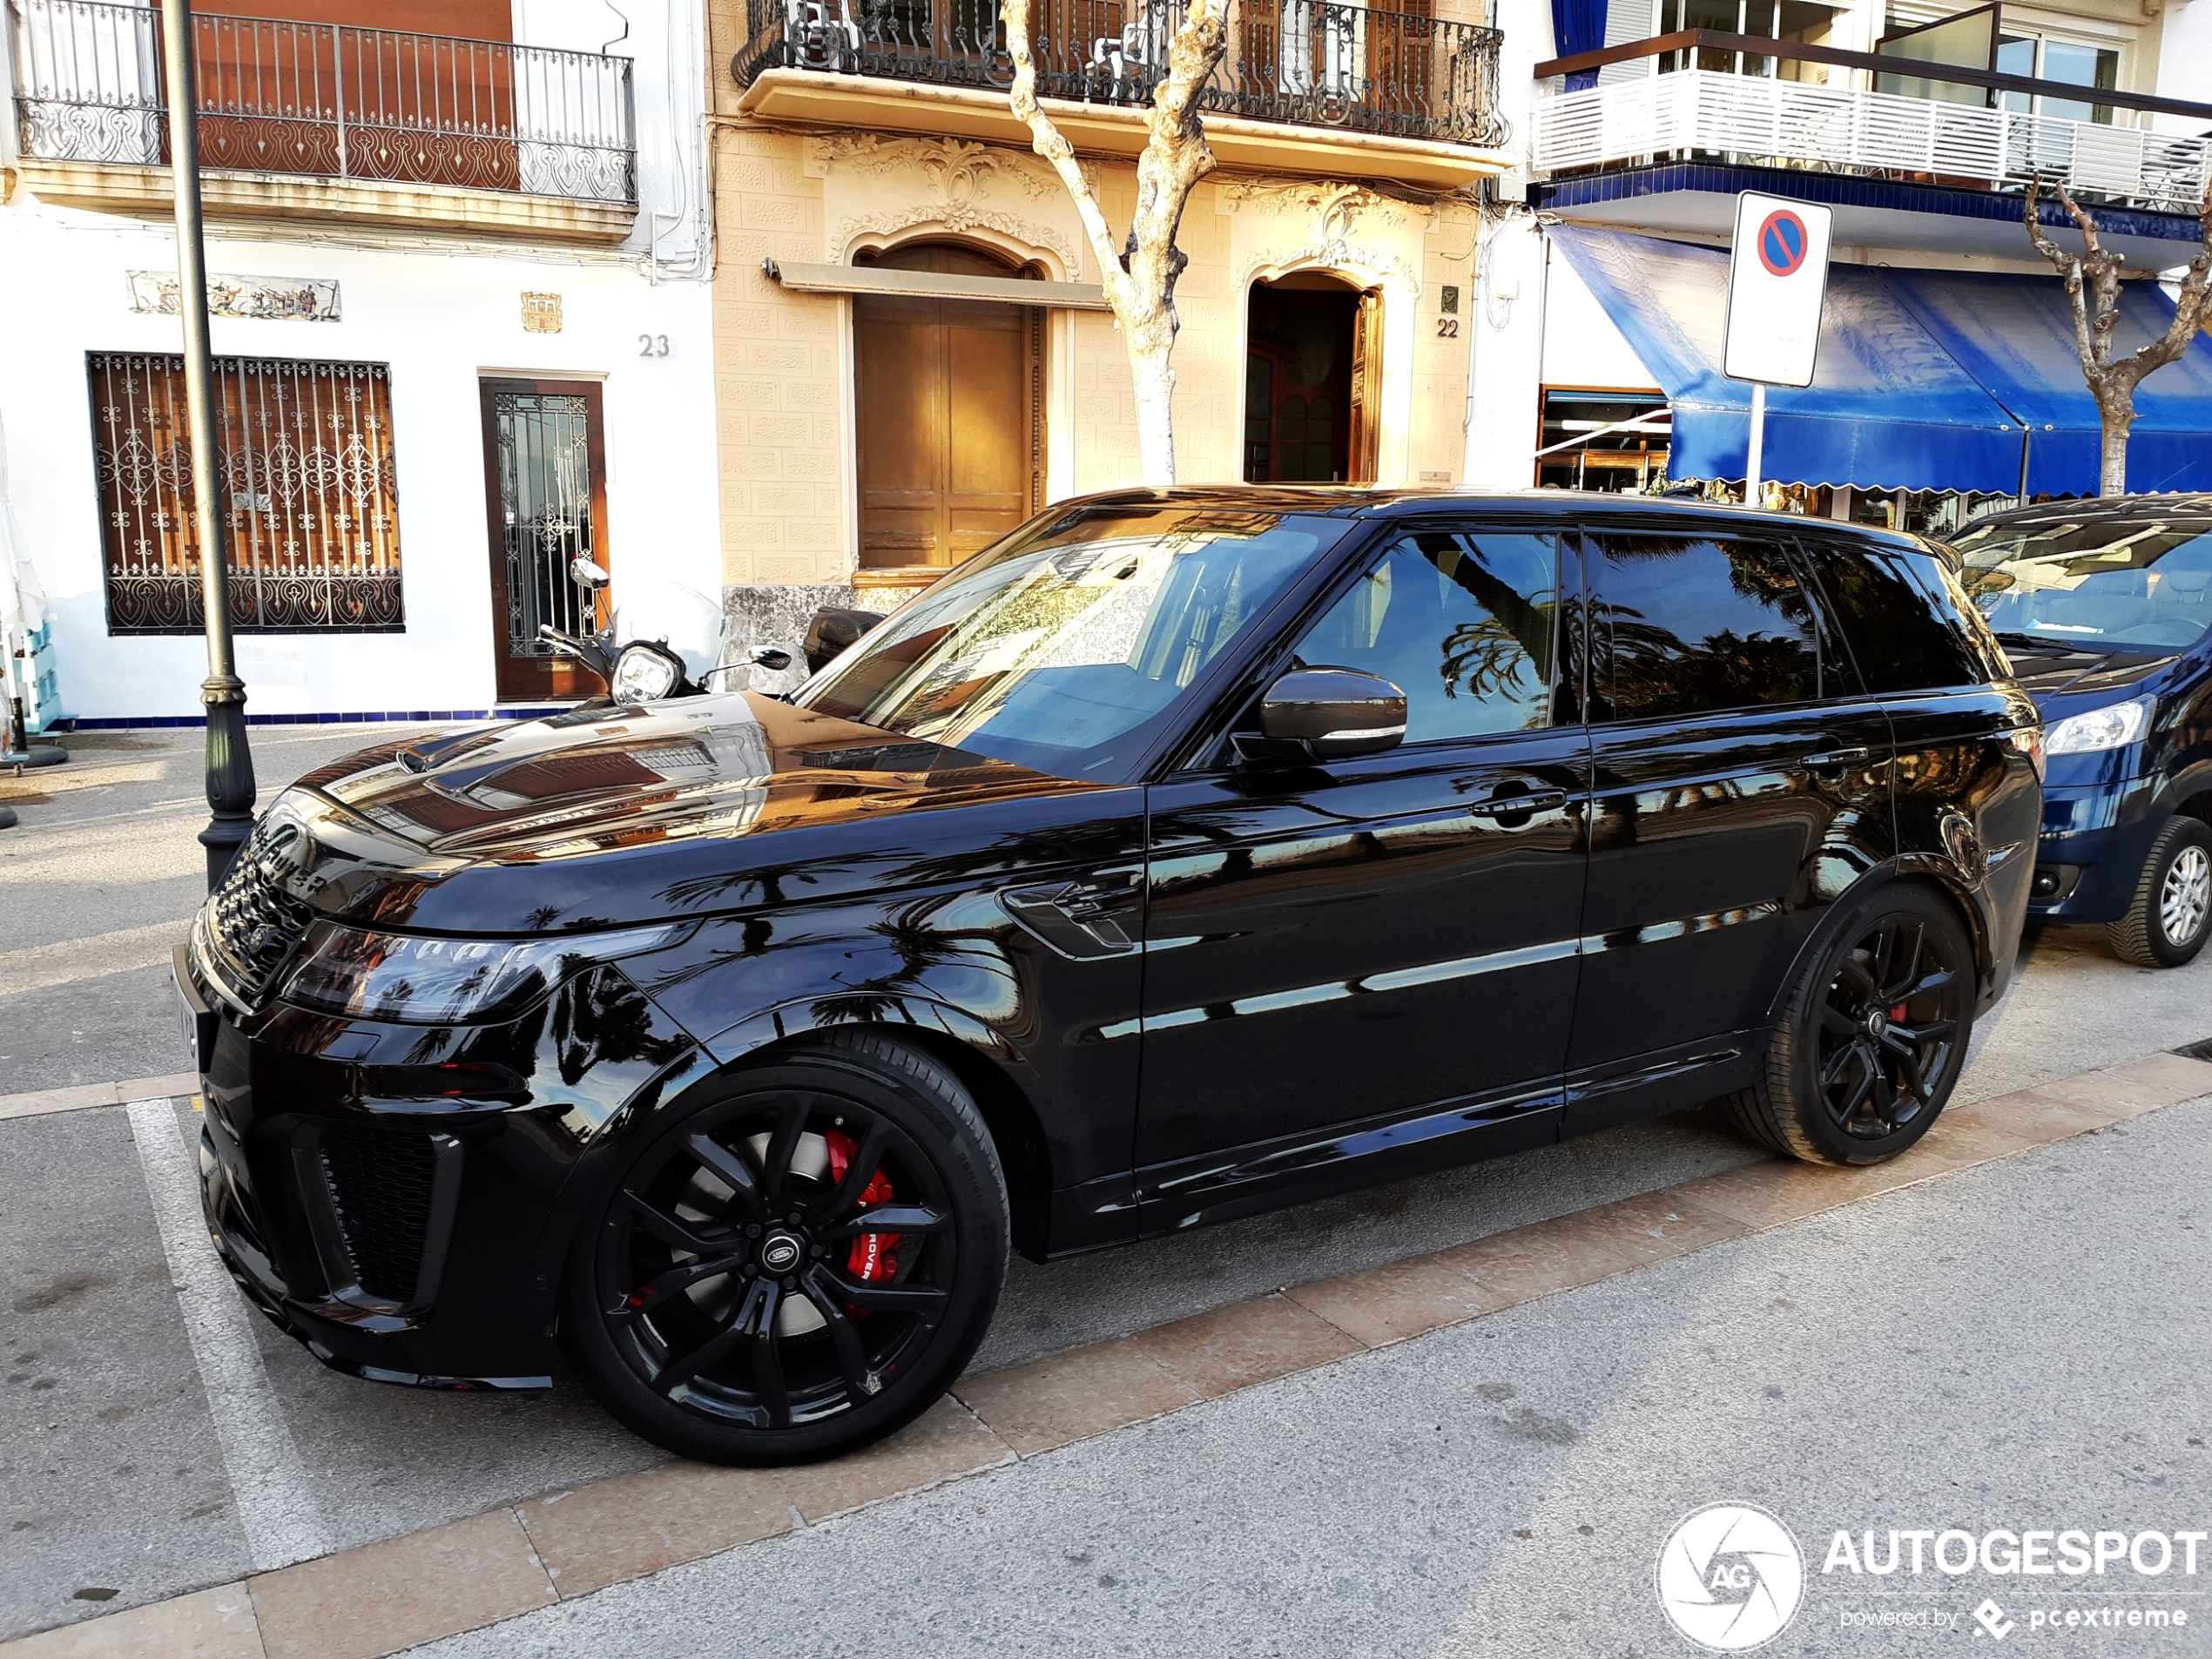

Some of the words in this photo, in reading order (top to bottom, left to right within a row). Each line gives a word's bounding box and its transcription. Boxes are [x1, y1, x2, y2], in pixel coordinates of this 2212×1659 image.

[638, 334, 669, 357] 23
[1438, 319, 1458, 338] 22
[266, 846, 327, 894] ROVER
[861, 1234, 876, 1279] ROVER
